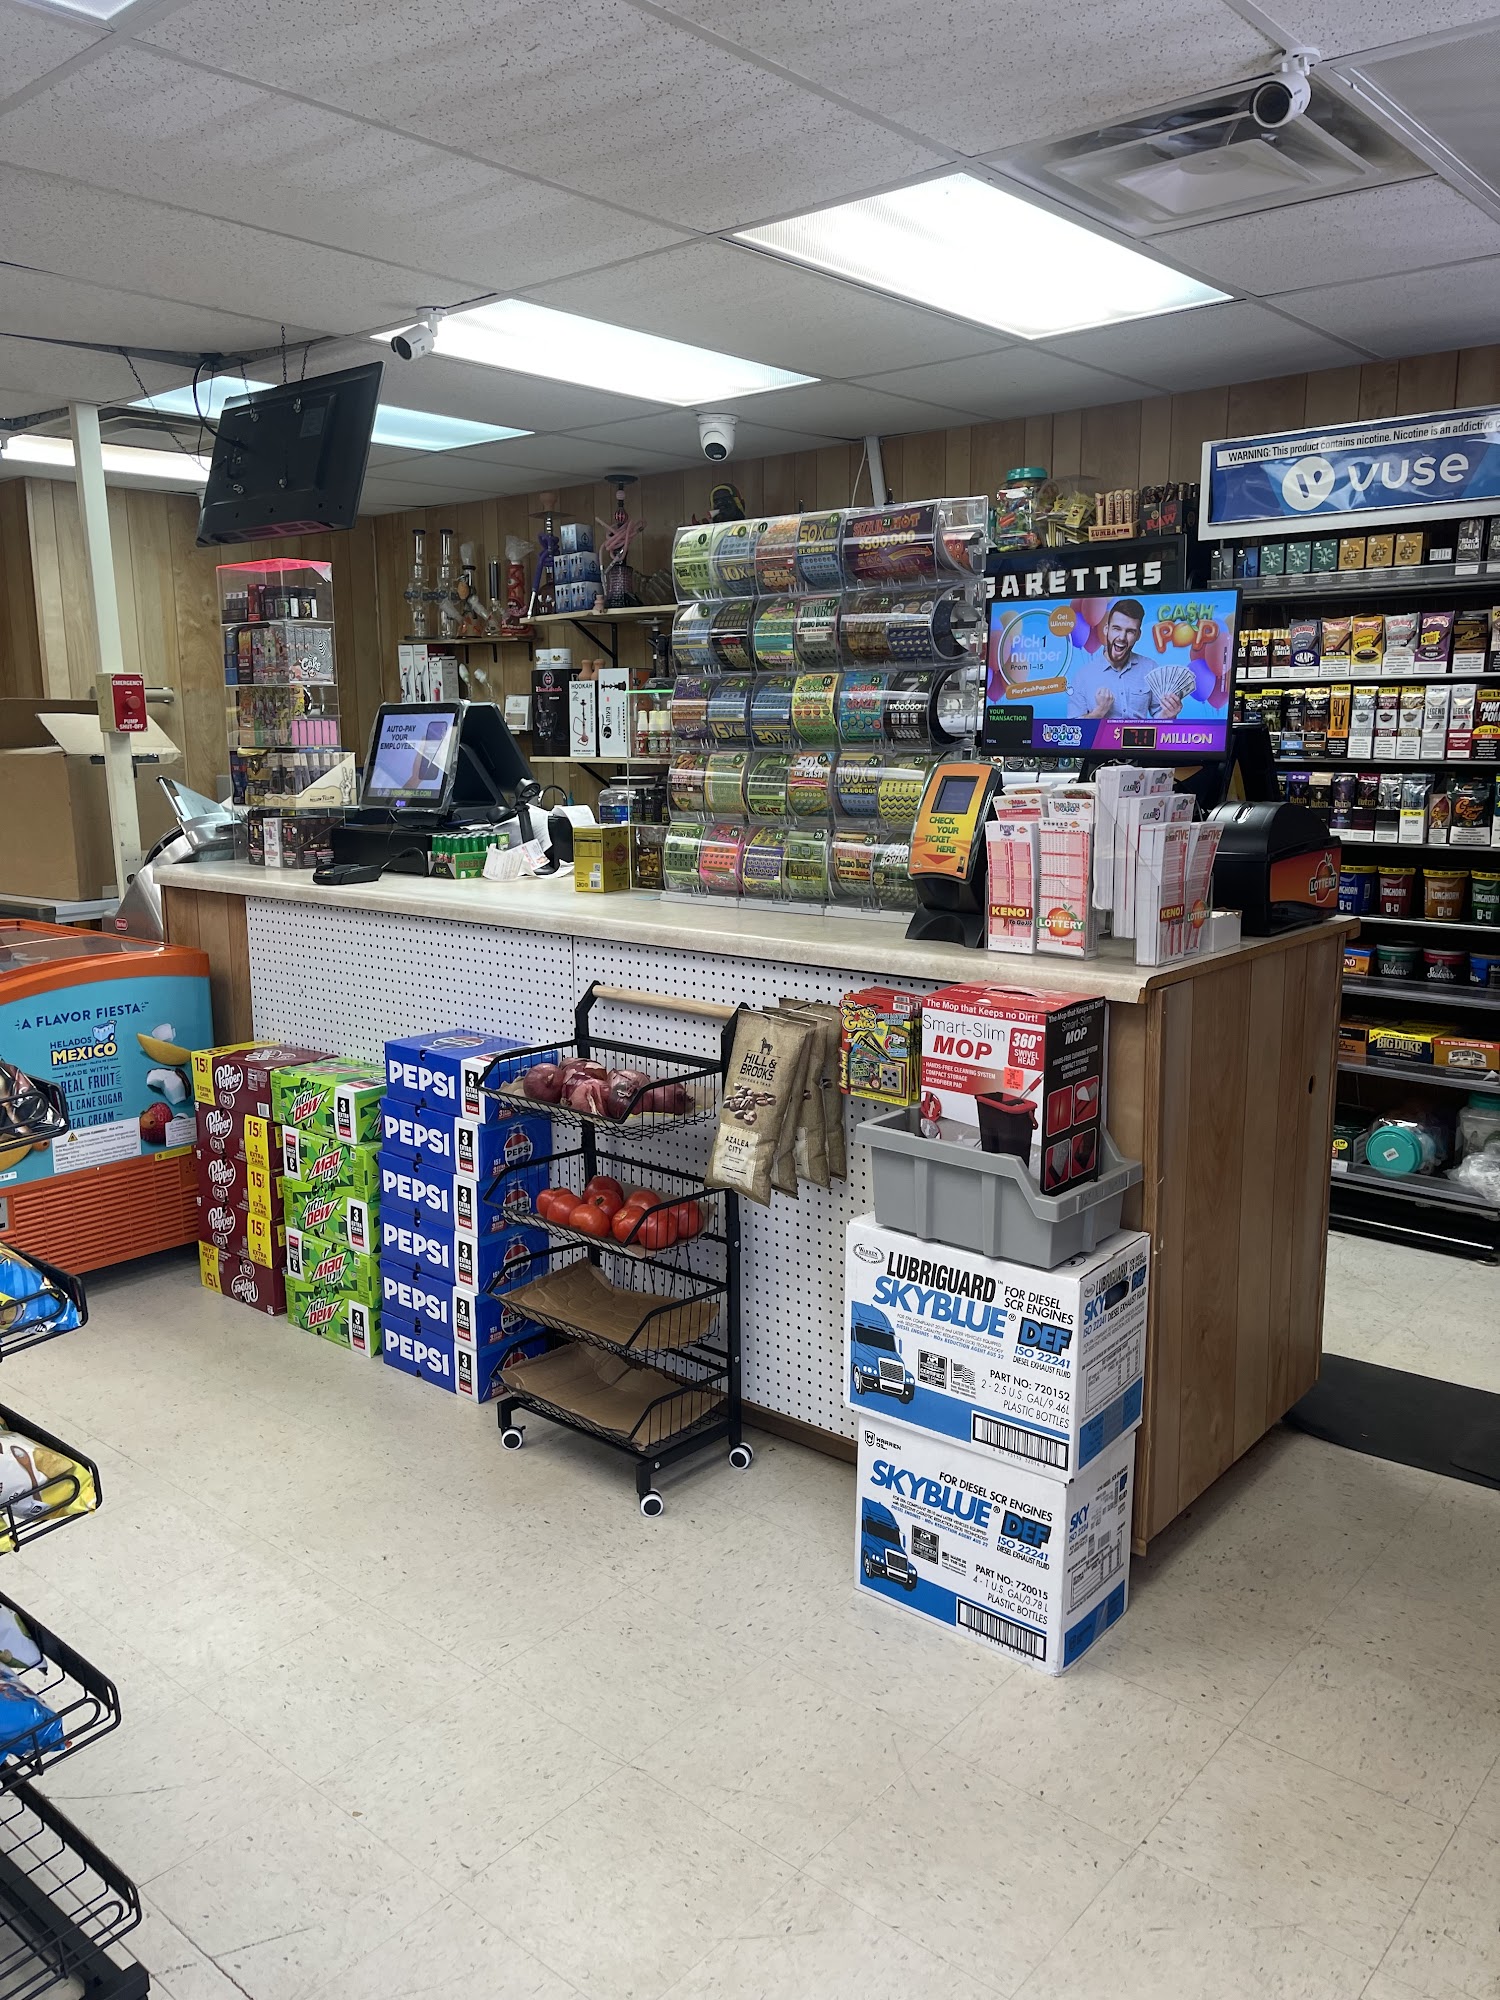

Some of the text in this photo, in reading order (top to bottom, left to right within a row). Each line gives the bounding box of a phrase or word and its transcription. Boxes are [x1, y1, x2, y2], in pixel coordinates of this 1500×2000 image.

[1228, 447, 1271, 462] WARNING:
[1272, 446, 1289, 456] This
[1290, 442, 1319, 454] product
[1320, 438, 1355, 449] contains
[1356, 433, 1392, 446] nicotine.
[1393, 429, 1429, 442] Nicotine
[1430, 426, 1438, 436] is
[1440, 425, 1451, 435] an
[1452, 420, 1493, 433] addictive
[1348, 453, 1469, 492] vuse
[890, 513, 920, 530] HOT
[1146, 512, 1178, 531] RAW
[1012, 634, 1047, 649] Pick 1
[1251, 645, 1268, 653] Black
[301, 657, 321, 670] Cake
[1011, 650, 1061, 663] number
[1294, 651, 1315, 663] GRAPE
[1011, 683, 1059, 694] PlayCashPop.com
[1427, 707, 1445, 715] LEGEND
[1113, 727, 1121, 740] $
[1160, 732, 1213, 745] MILLION
[804, 771, 823, 779] CASH
[929, 815, 955, 825] CHECK
[925, 834, 950, 844] TICKET
[937, 825, 959, 835] YOUR
[1175, 829, 1189, 840] FIVE
[936, 844, 956, 854] HERE
[1311, 877, 1337, 892] LOTTERY
[1381, 887, 1407, 897] LONGHORN
[1431, 891, 1460, 900] LONGHORN
[1472, 892, 1500, 904] LONGHORN
[991, 906, 1031, 918] KENO!
[1161, 905, 1184, 918] KENO!
[1187, 910, 1211, 922] LOTTERY
[1039, 918, 1084, 931] LOTTERY
[21, 1003, 141, 1030] A FLAVOR FIESTA
[926, 999, 1038, 1022] The Mop that Keeps no Dirt!
[922, 1014, 1005, 1042] Smart-Slim
[1065, 1027, 1088, 1045] MOP
[50, 1037, 92, 1049] HELADOS
[933, 1035, 992, 1060] MOP
[1012, 1032, 1042, 1050] 360°
[1376, 1036, 1398, 1050] BIG
[1398, 1039, 1423, 1055] DUKE
[744, 1053, 777, 1069] HILL &
[1014, 1049, 1039, 1060] SWIVEL
[1017, 1056, 1036, 1066] HEAD
[65, 1066, 109, 1077] MADE WITH
[195, 1057, 205, 1073] 15
[740, 1063, 775, 1081] BROOKS
[925, 1062, 996, 1080] HANDS-FREE CLEANING SYSTEM
[61, 1072, 115, 1093] REAL FRUIT
[215, 1066, 240, 1090] Pepper
[388, 1060, 456, 1100] PEPSI
[925, 1069, 967, 1082] COMPACT STORAGE
[75, 1092, 123, 1110] CANE SUGAR
[88, 1111, 114, 1125] CREAM
[206, 1112, 231, 1135] Pepper
[384, 1115, 450, 1157] PEPSI
[725, 1135, 750, 1148] AZALEA
[727, 1144, 742, 1155] CITY
[209, 1161, 234, 1184] Pepper
[382, 1169, 448, 1213] PEPSI
[208, 1207, 234, 1231] Pepper
[383, 1223, 449, 1268] PEPSI
[886, 1251, 997, 1303] LUBRIGUARD
[384, 1277, 448, 1324] PEPSI
[873, 1275, 1008, 1339] SKYBLUE
[1004, 1286, 1061, 1310] FOR DIESEL
[1004, 1297, 1074, 1325] SCR ENGINES
[1018, 1317, 1072, 1356] DEF
[385, 1328, 450, 1376] PEPSI
[1015, 1345, 1071, 1370] ISO 22241
[990, 1370, 1070, 1402] PART NO: 720152
[981, 1380, 1069, 1415] 2 2.5 U.S. GAL/9.46L
[1003, 1400, 1069, 1429] PLASTIC BOTTLES
[876, 1438, 902, 1450] WARREN
[870, 1459, 993, 1529] SKYBLUE
[939, 1472, 1053, 1522] FOR DIESEL SCR ENGINES
[1002, 1511, 1052, 1549] DEF
[998, 1536, 1049, 1562] ISO 22241
[975, 1563, 995, 1579] PART
[997, 1573, 1014, 1586] NO:
[1016, 1580, 1049, 1600] 720015
[987, 1593, 1048, 1625] PLASTIC BOTTLES
